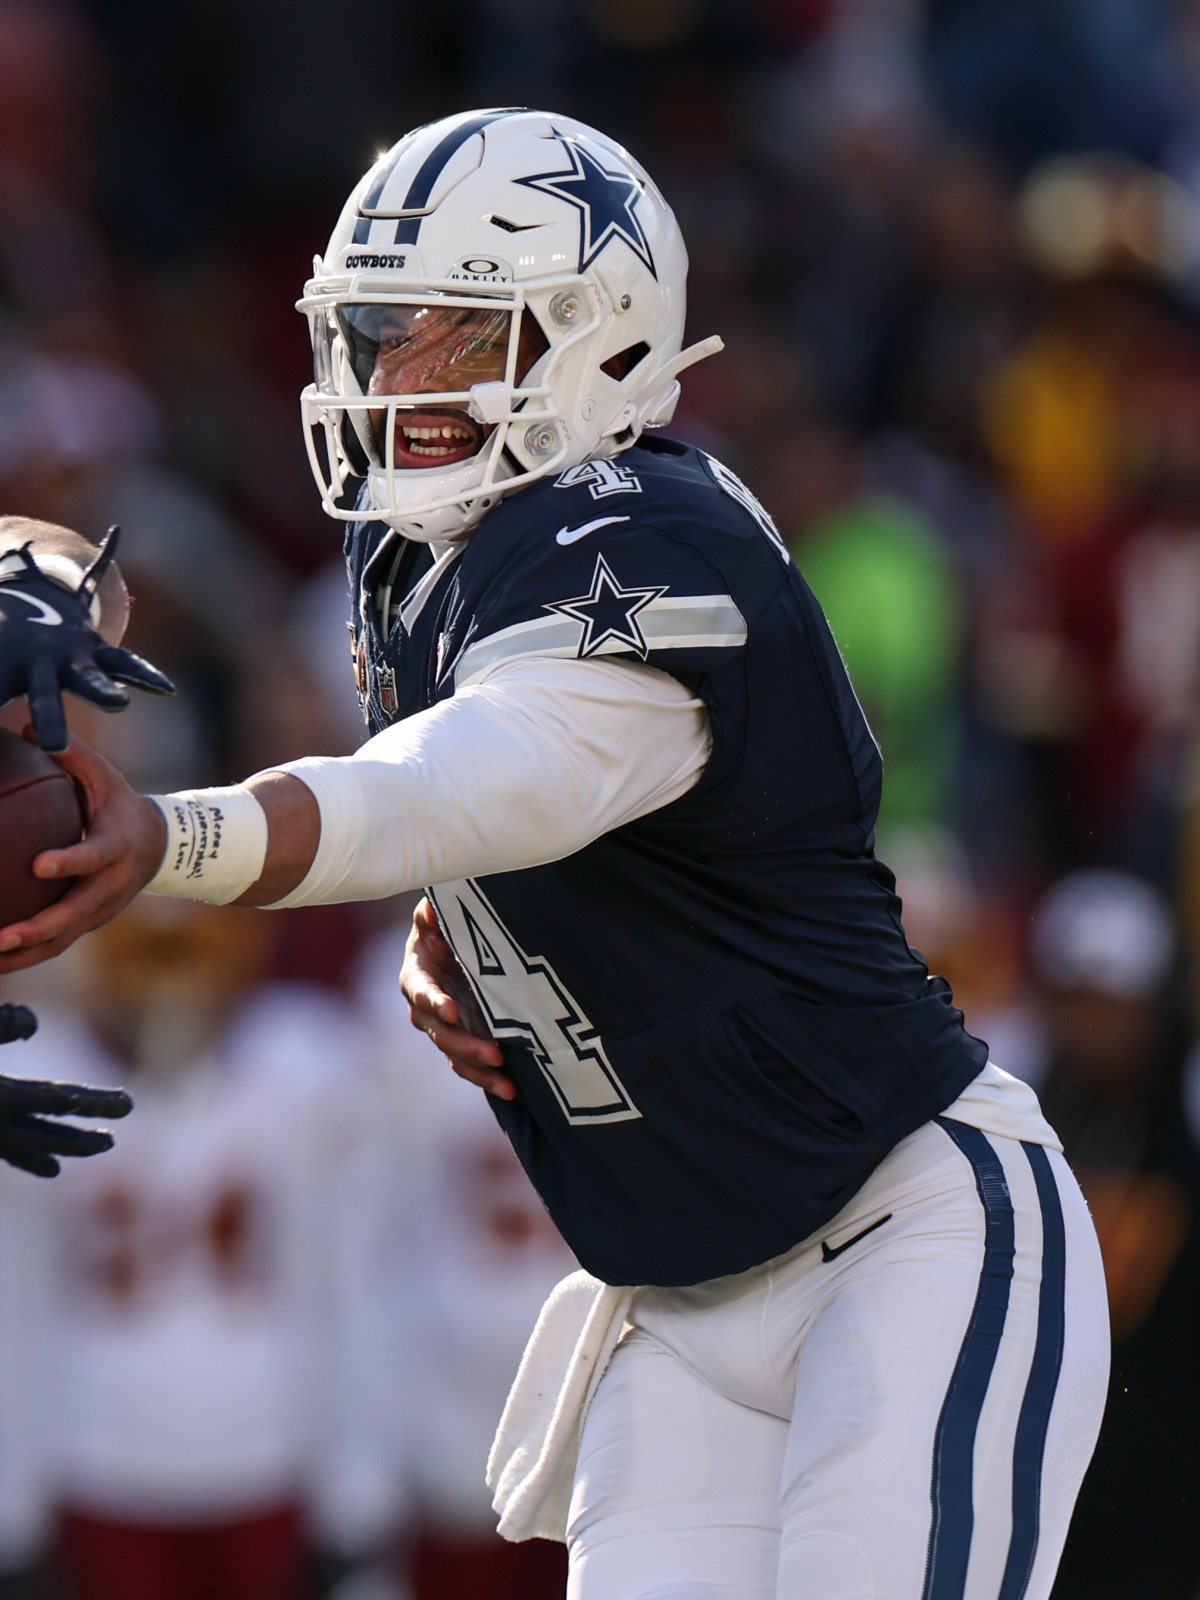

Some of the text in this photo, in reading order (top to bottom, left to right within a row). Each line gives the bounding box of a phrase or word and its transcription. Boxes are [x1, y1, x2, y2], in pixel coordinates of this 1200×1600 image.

[345, 255, 406, 269] COWBOYS
[451, 273, 509, 283] OAKLEY
[553, 457, 643, 500] 4
[424, 877, 644, 1126] 4
